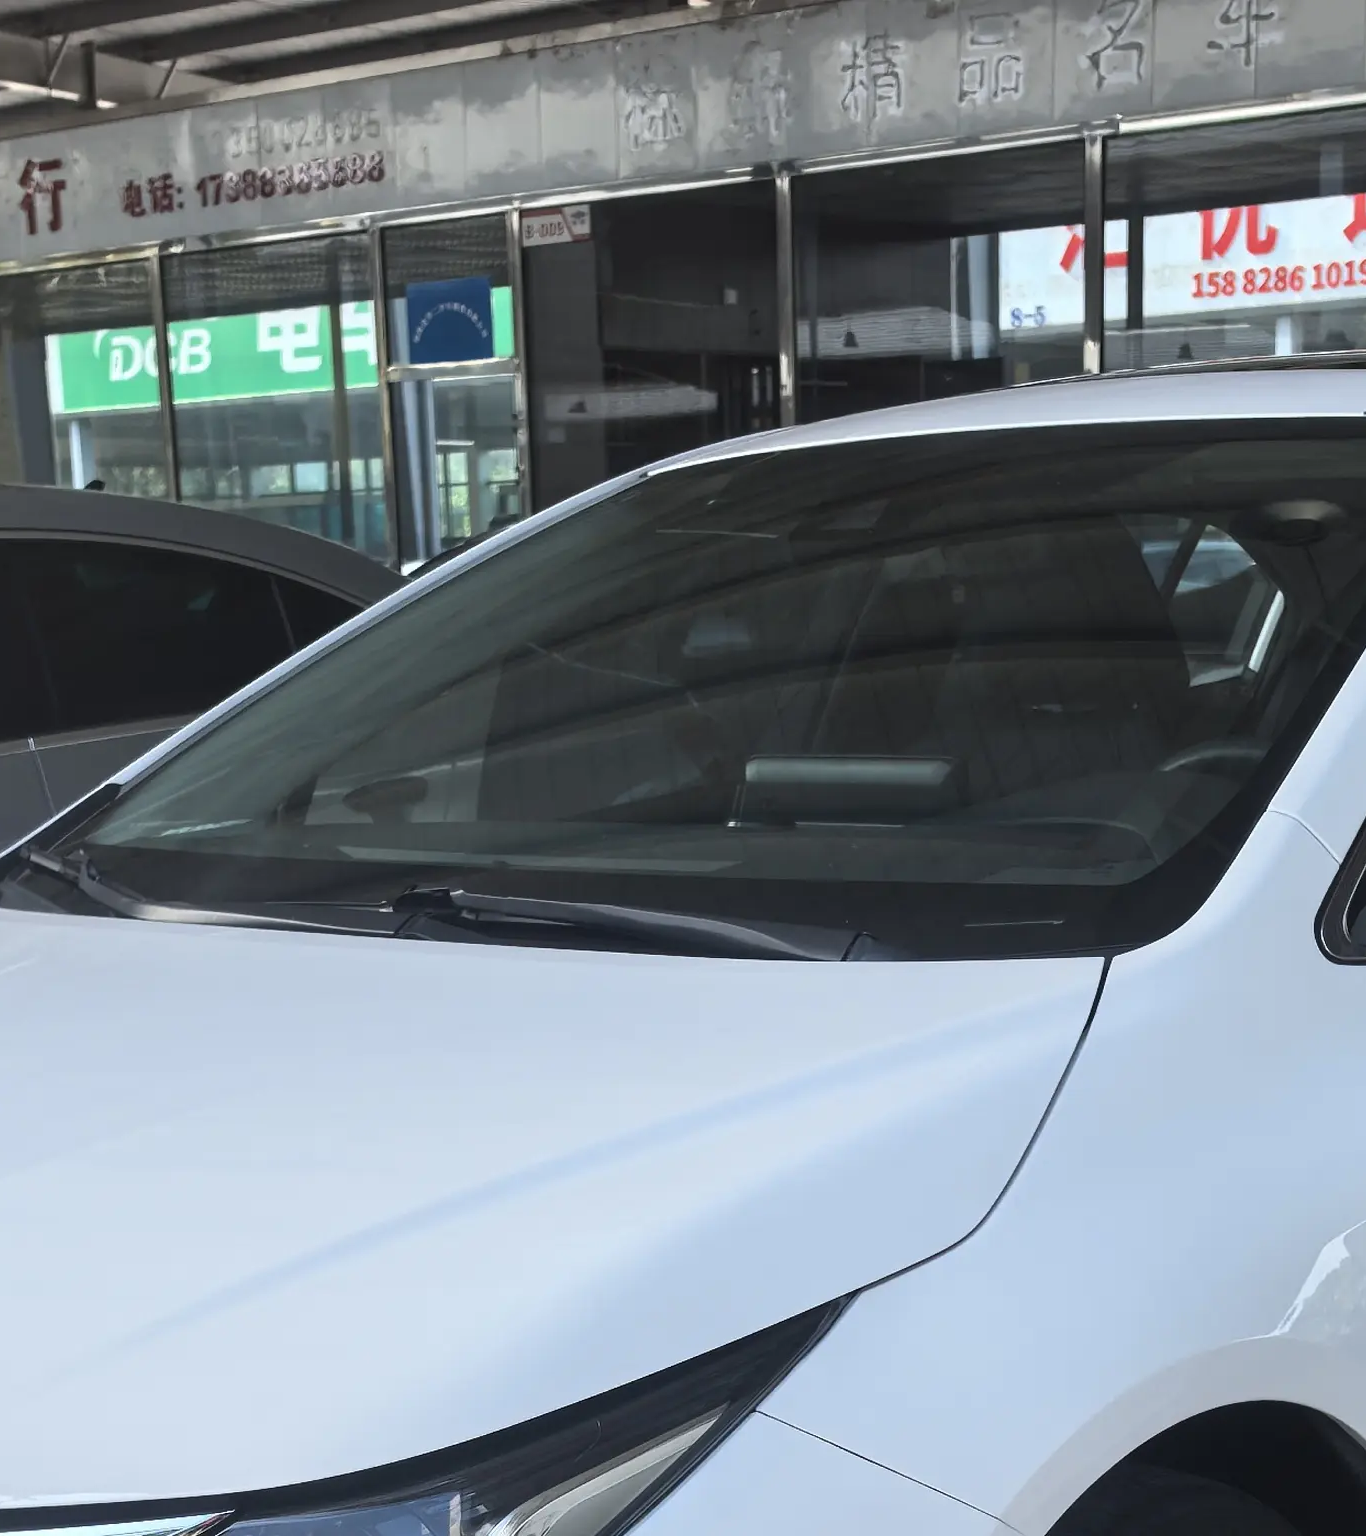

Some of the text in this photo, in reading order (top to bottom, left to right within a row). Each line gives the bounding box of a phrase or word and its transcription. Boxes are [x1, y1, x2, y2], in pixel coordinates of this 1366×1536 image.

[1192, 271, 1235, 299] 158
[1242, 264, 1303, 295] 8286
[1010, 304, 1047, 329] 8-5
